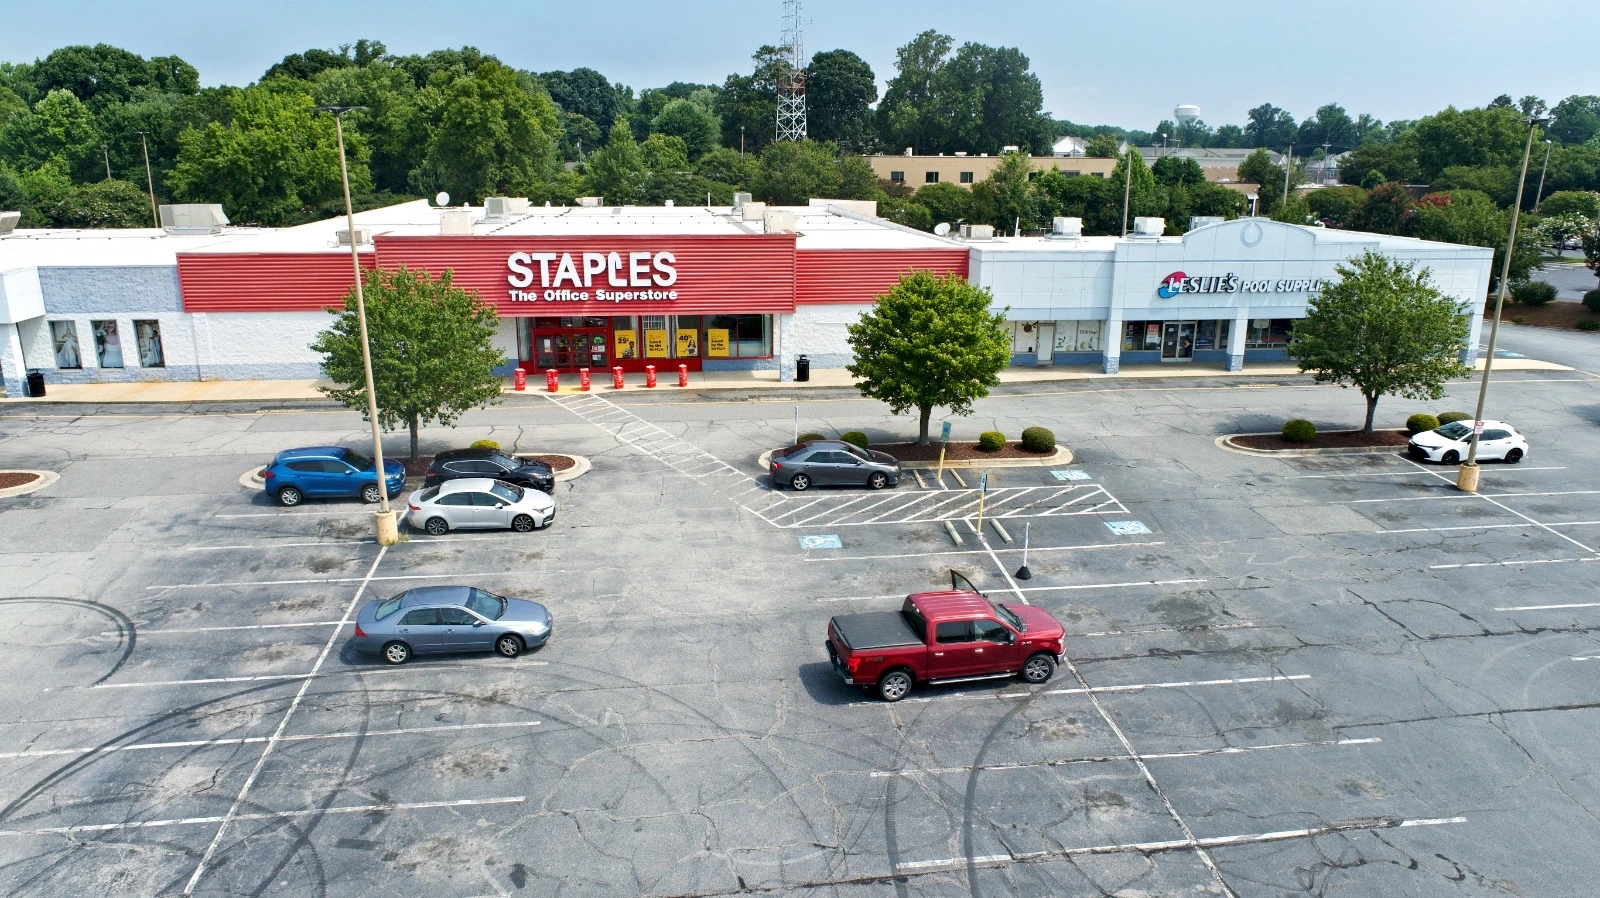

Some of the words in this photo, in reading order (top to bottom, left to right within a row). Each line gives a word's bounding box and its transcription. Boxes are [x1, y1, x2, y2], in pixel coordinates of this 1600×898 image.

[507, 251, 677, 287] STAPLES
[1168, 273, 1239, 293] LESLIE'S
[1241, 280, 1273, 293] POOL
[509, 290, 537, 302] The
[544, 290, 589, 301] Office
[595, 289, 678, 302] Superstore
